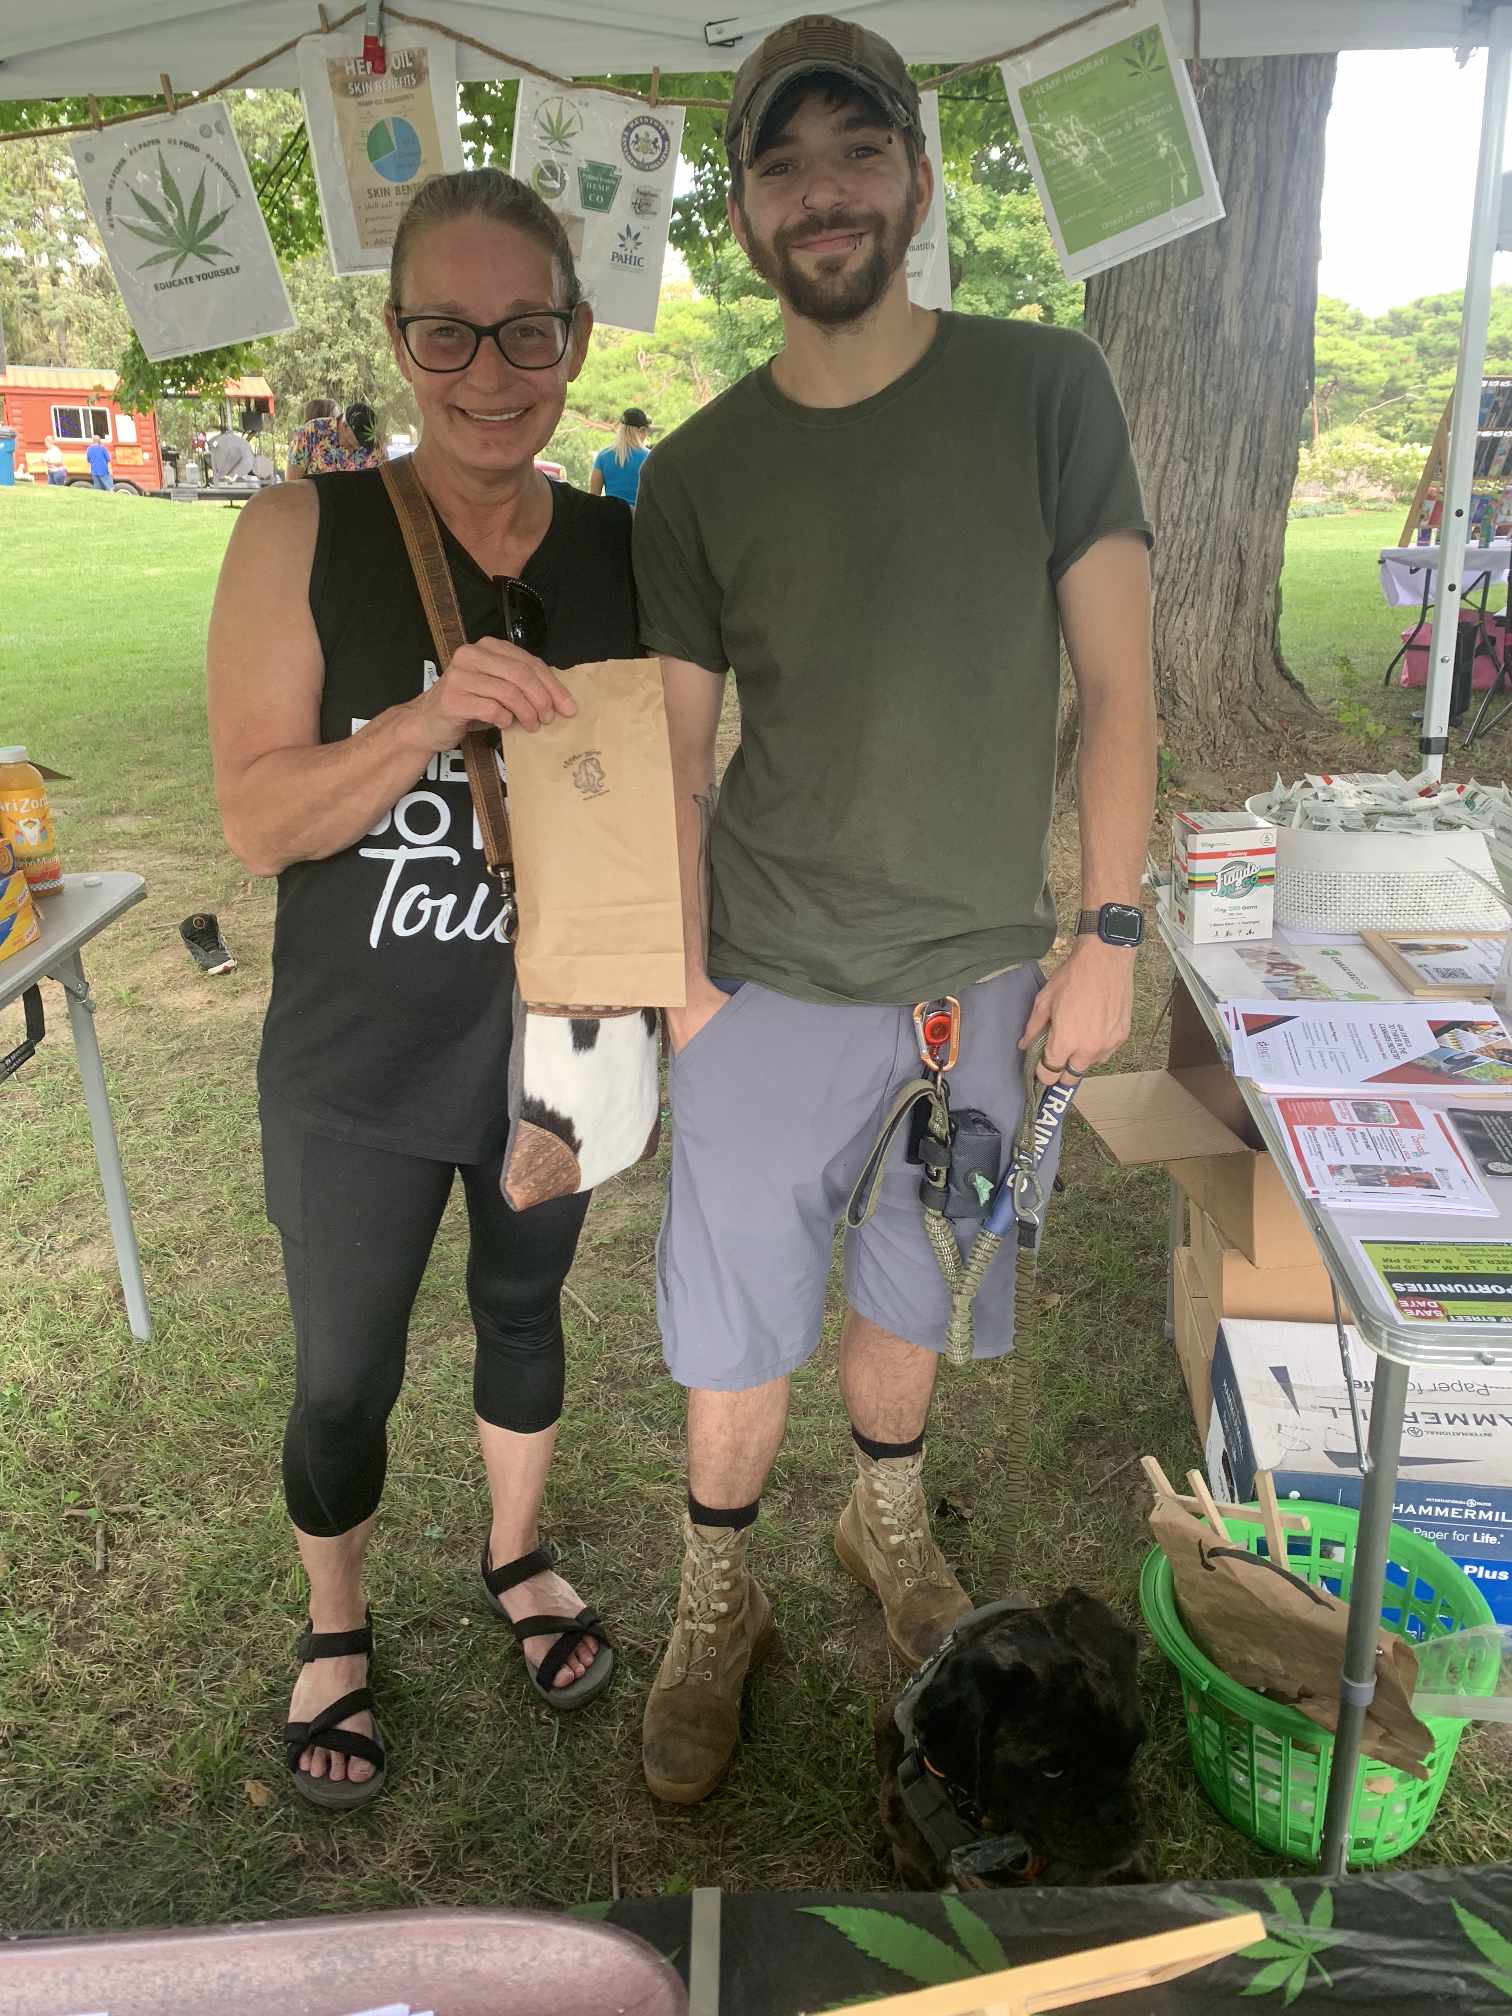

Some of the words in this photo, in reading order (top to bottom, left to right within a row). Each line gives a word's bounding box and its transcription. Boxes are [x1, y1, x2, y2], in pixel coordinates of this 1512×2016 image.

[390, 50, 413, 70] OIL
[348, 79, 374, 95] SKIN
[374, 73, 417, 92] BENEFITS
[367, 186, 391, 199] SKIN
[908, 240, 935, 251] matitis
[611, 251, 646, 268] PAHIC
[153, 275, 195, 292] EDUCATE
[196, 264, 242, 284] YOURSELF
[0, 789, 48, 814] AriZon
[358, 844, 512, 949] Tou
[1397, 1299, 1438, 1309] DATE
[1403, 1308, 1444, 1318] SAVE
[1431, 1379, 1491, 1396] Paper
[1392, 1503, 1512, 1523] HAMMERMIL
[1413, 1527, 1449, 1546] Paper
[1452, 1530, 1470, 1542] for
[1463, 1564, 1510, 1581] Plus
